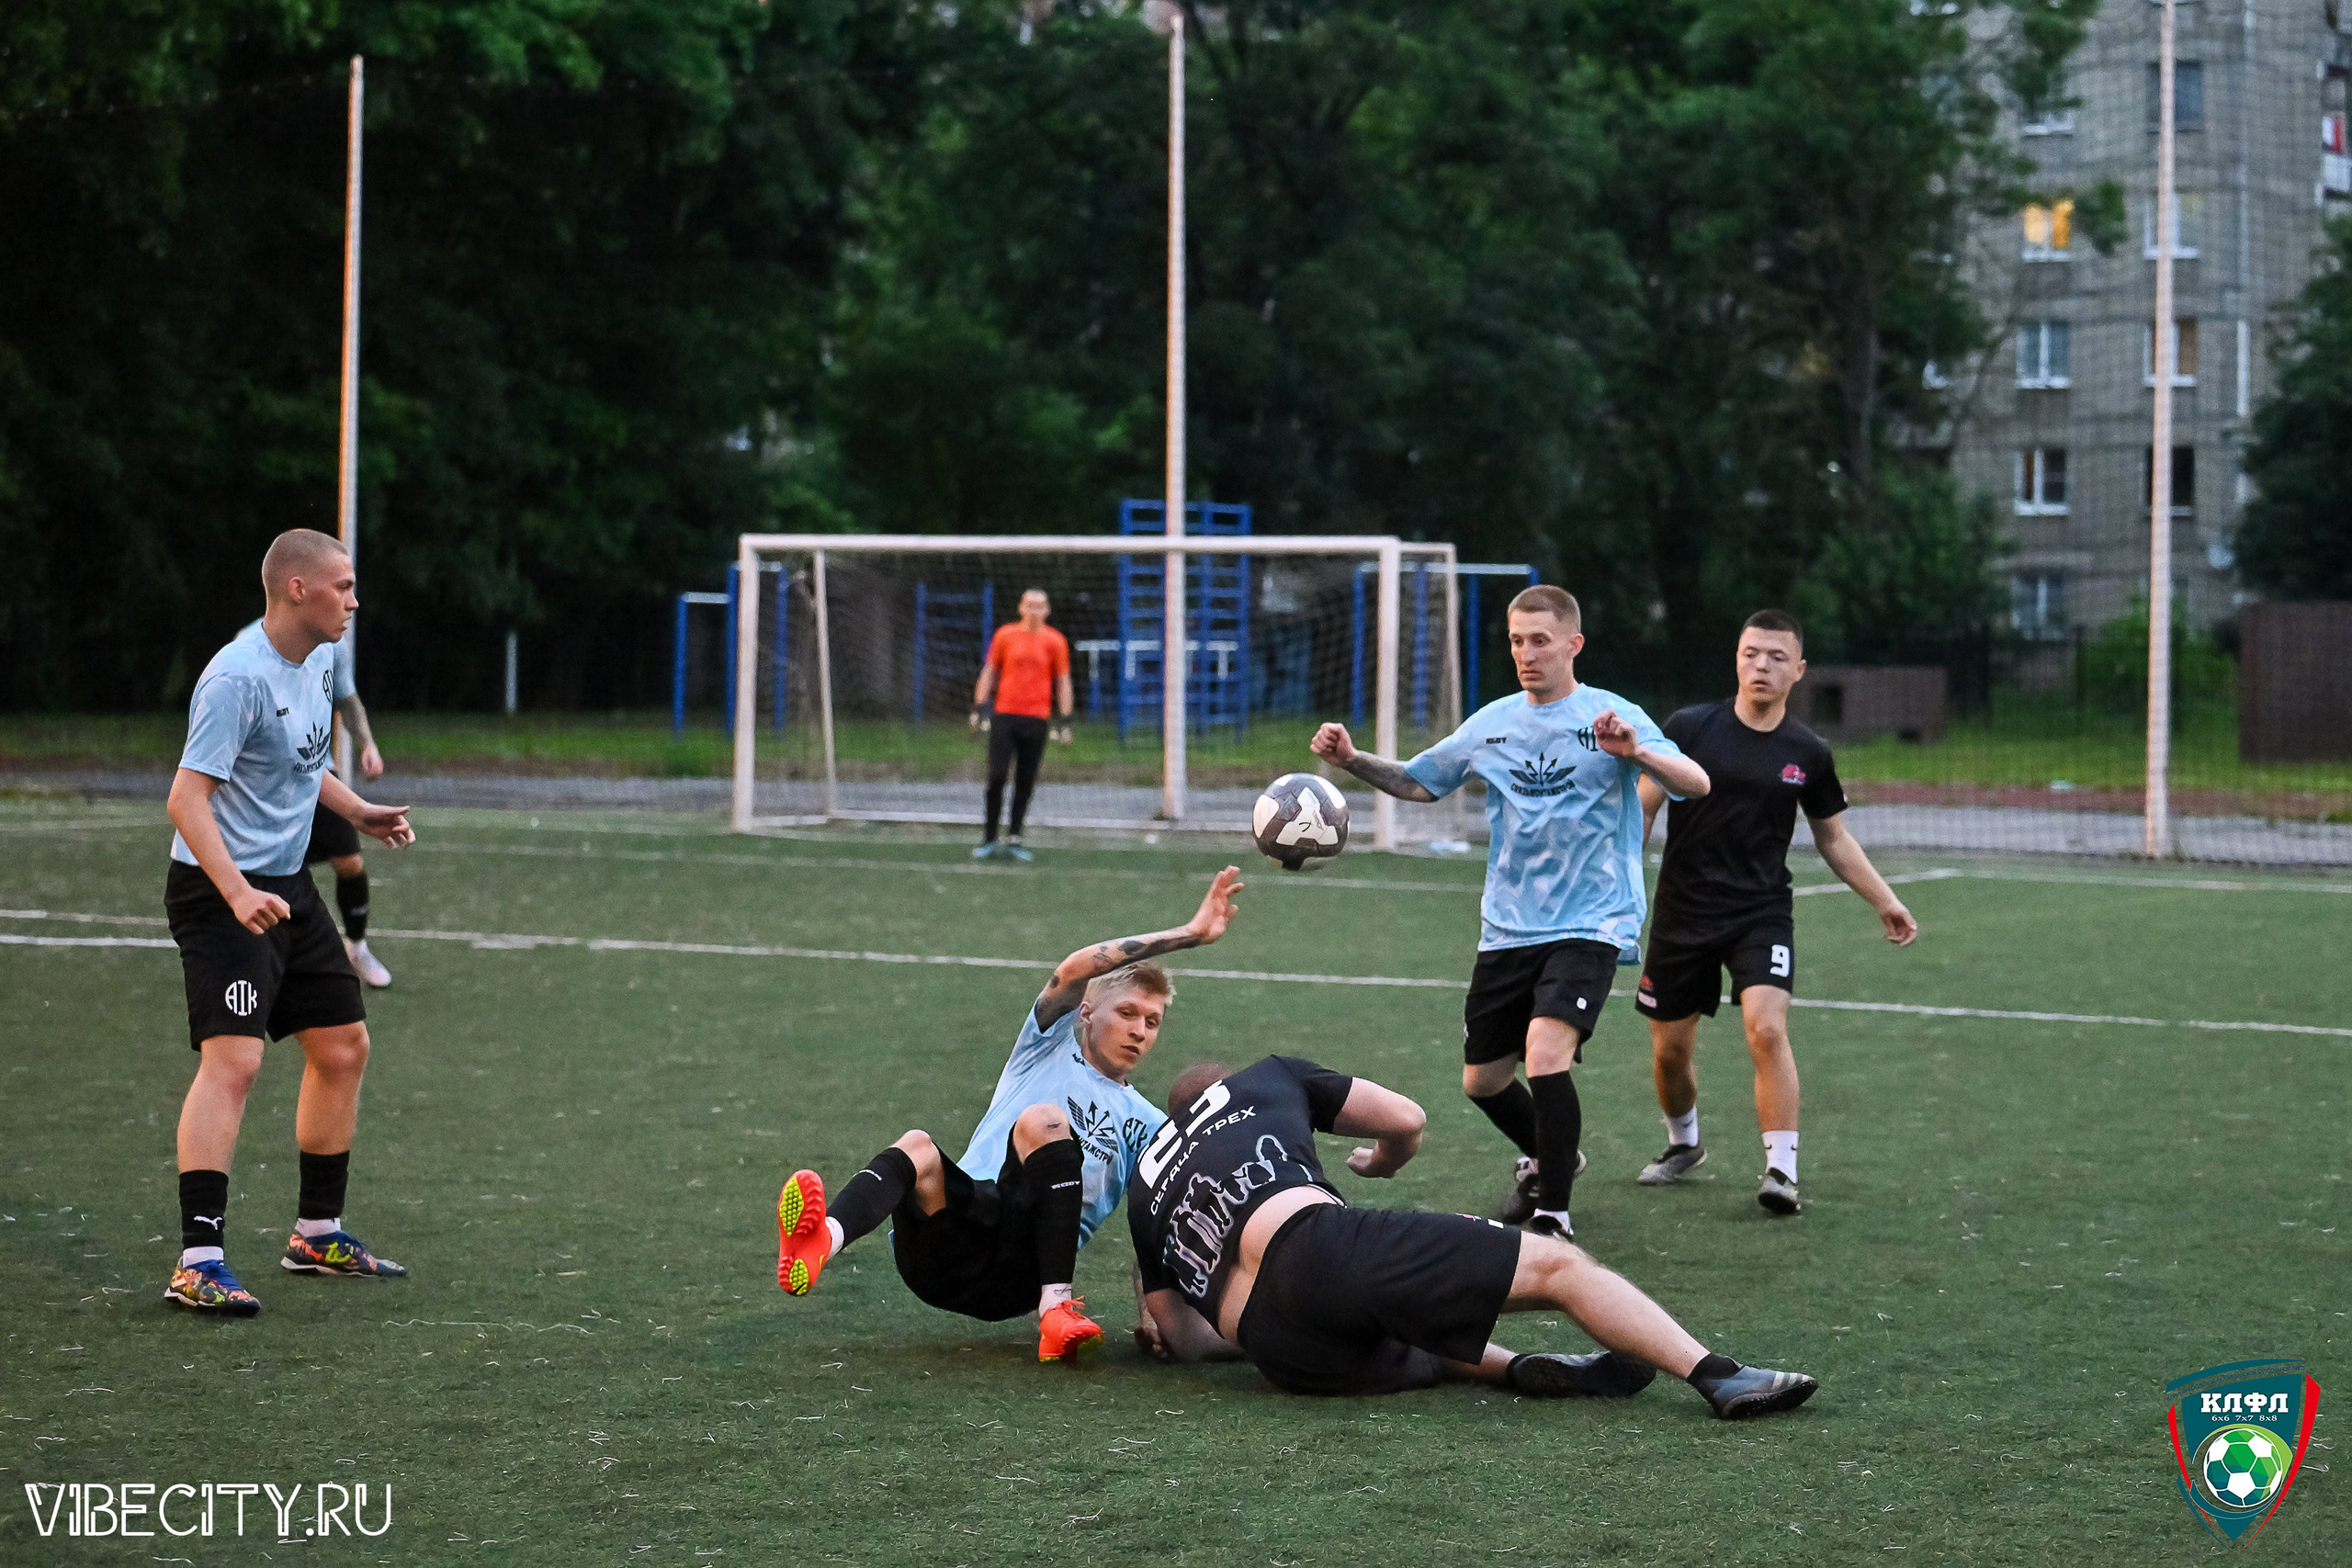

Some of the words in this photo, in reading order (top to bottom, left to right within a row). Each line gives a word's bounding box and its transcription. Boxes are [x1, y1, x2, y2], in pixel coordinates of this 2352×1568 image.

[1770, 947, 1790, 977] 9
[1150, 1141, 1199, 1216] СЕРДЦА
[1202, 1105, 1257, 1136] ТРЕХ
